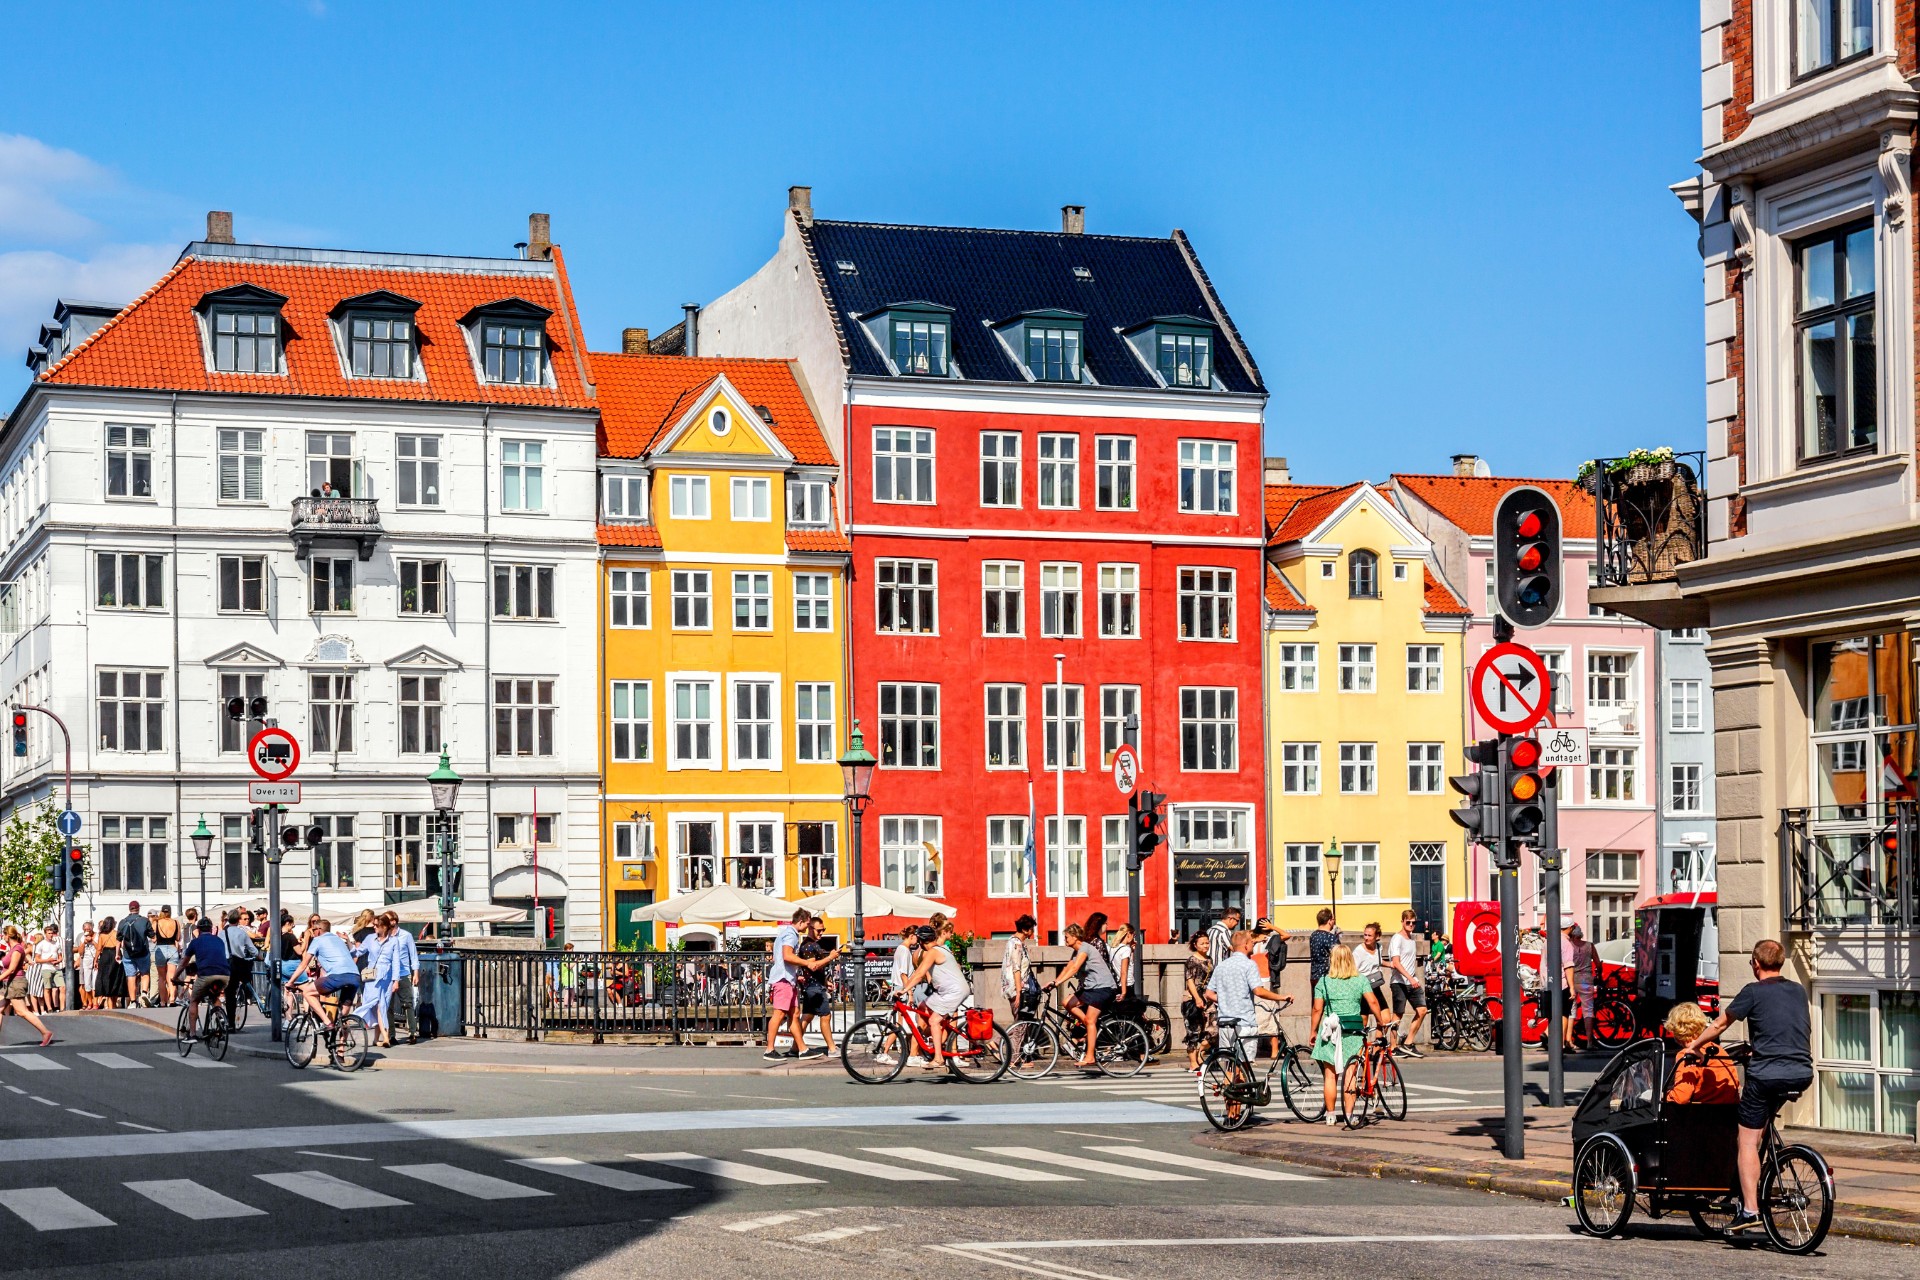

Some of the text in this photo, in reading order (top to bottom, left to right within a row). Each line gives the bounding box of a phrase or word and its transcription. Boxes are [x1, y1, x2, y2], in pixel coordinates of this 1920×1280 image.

[1545, 754, 1582, 763] undtaget
[255, 788, 294, 796] Over 12 t
